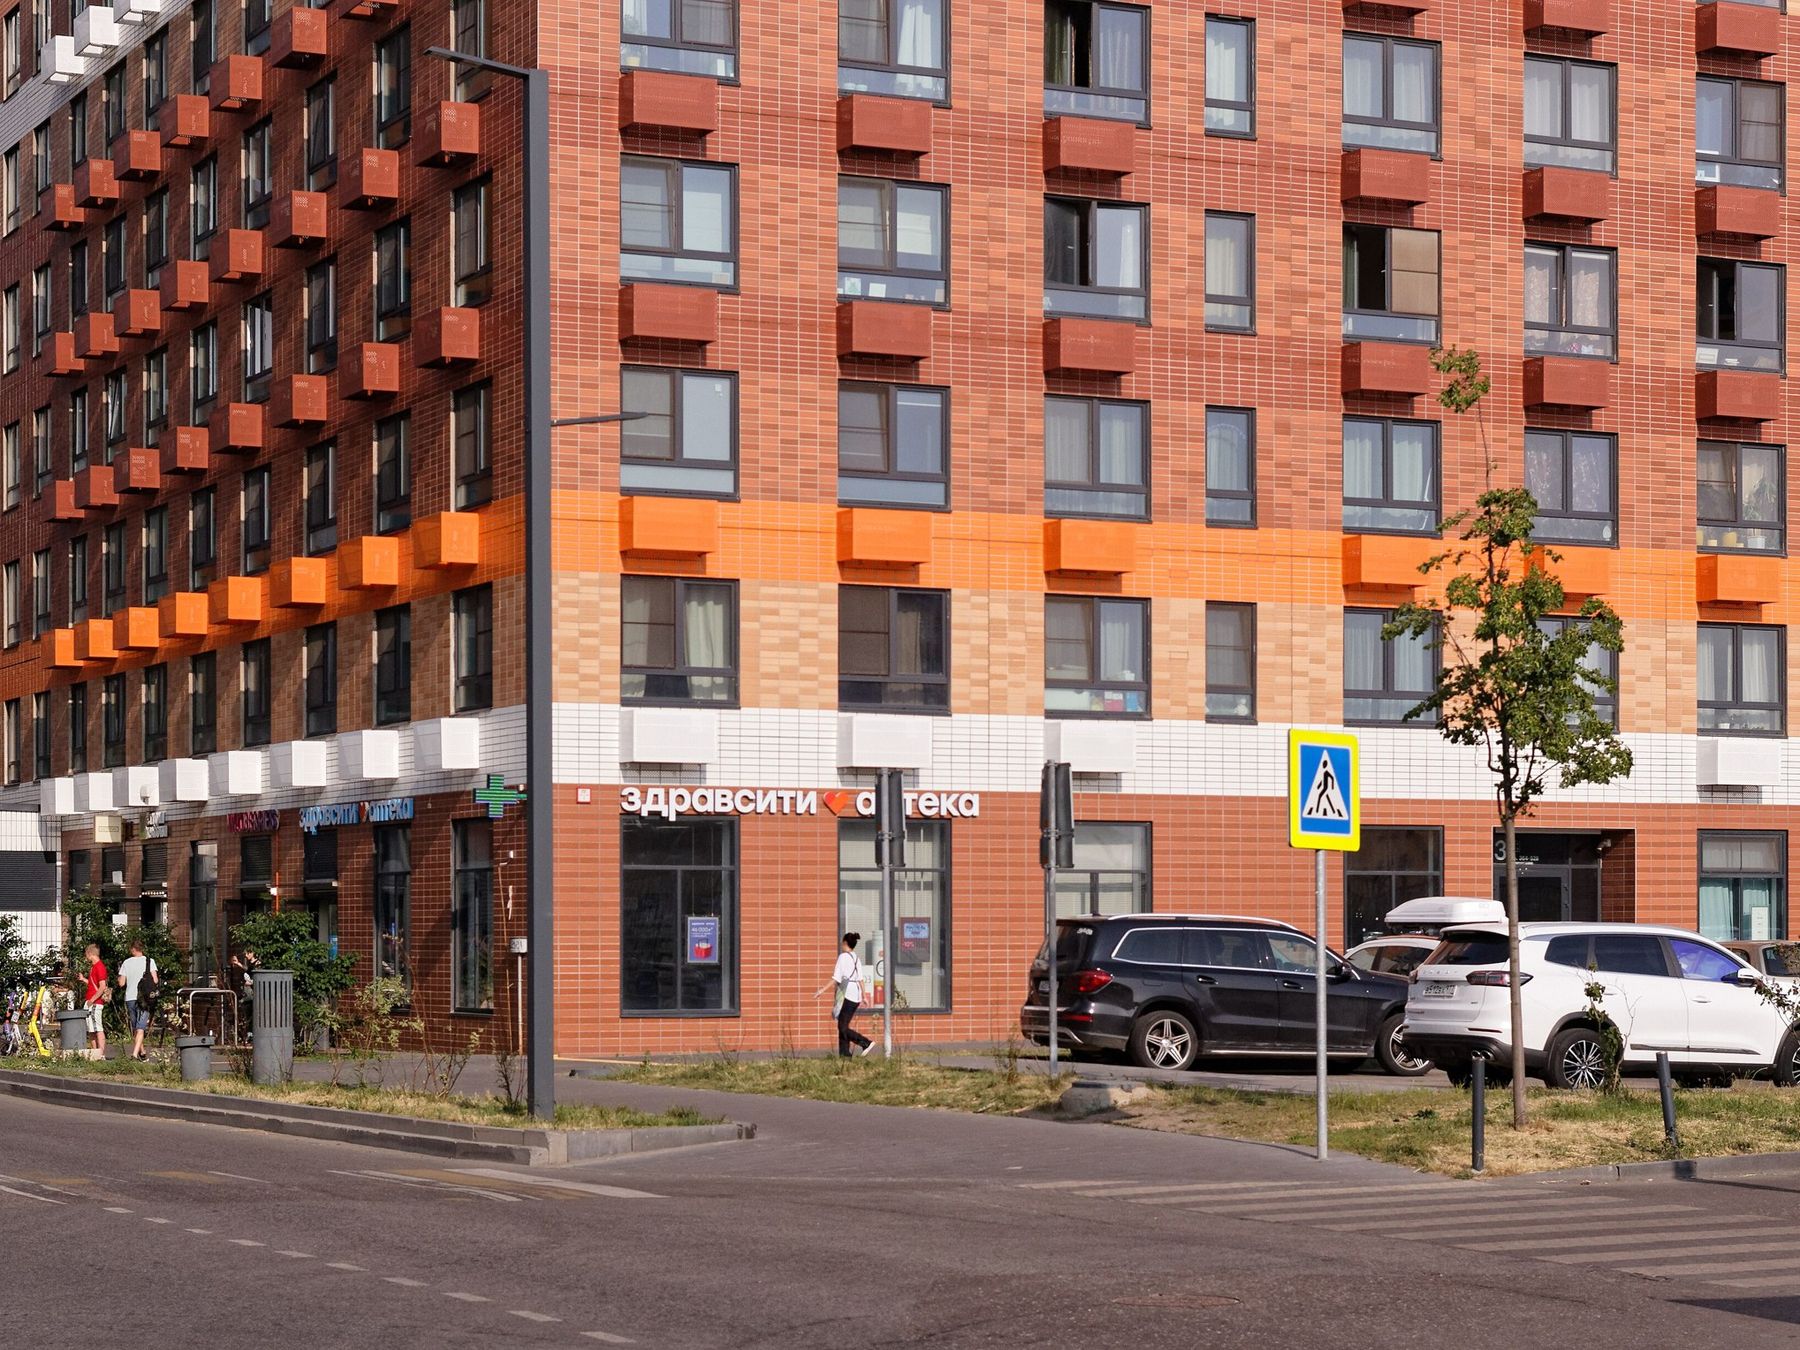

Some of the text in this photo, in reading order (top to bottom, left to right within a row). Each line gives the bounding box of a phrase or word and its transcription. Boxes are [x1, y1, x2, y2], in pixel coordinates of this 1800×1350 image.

[298, 798, 414, 835] здравсити аптека
[620, 787, 979, 821] здравсити атека
